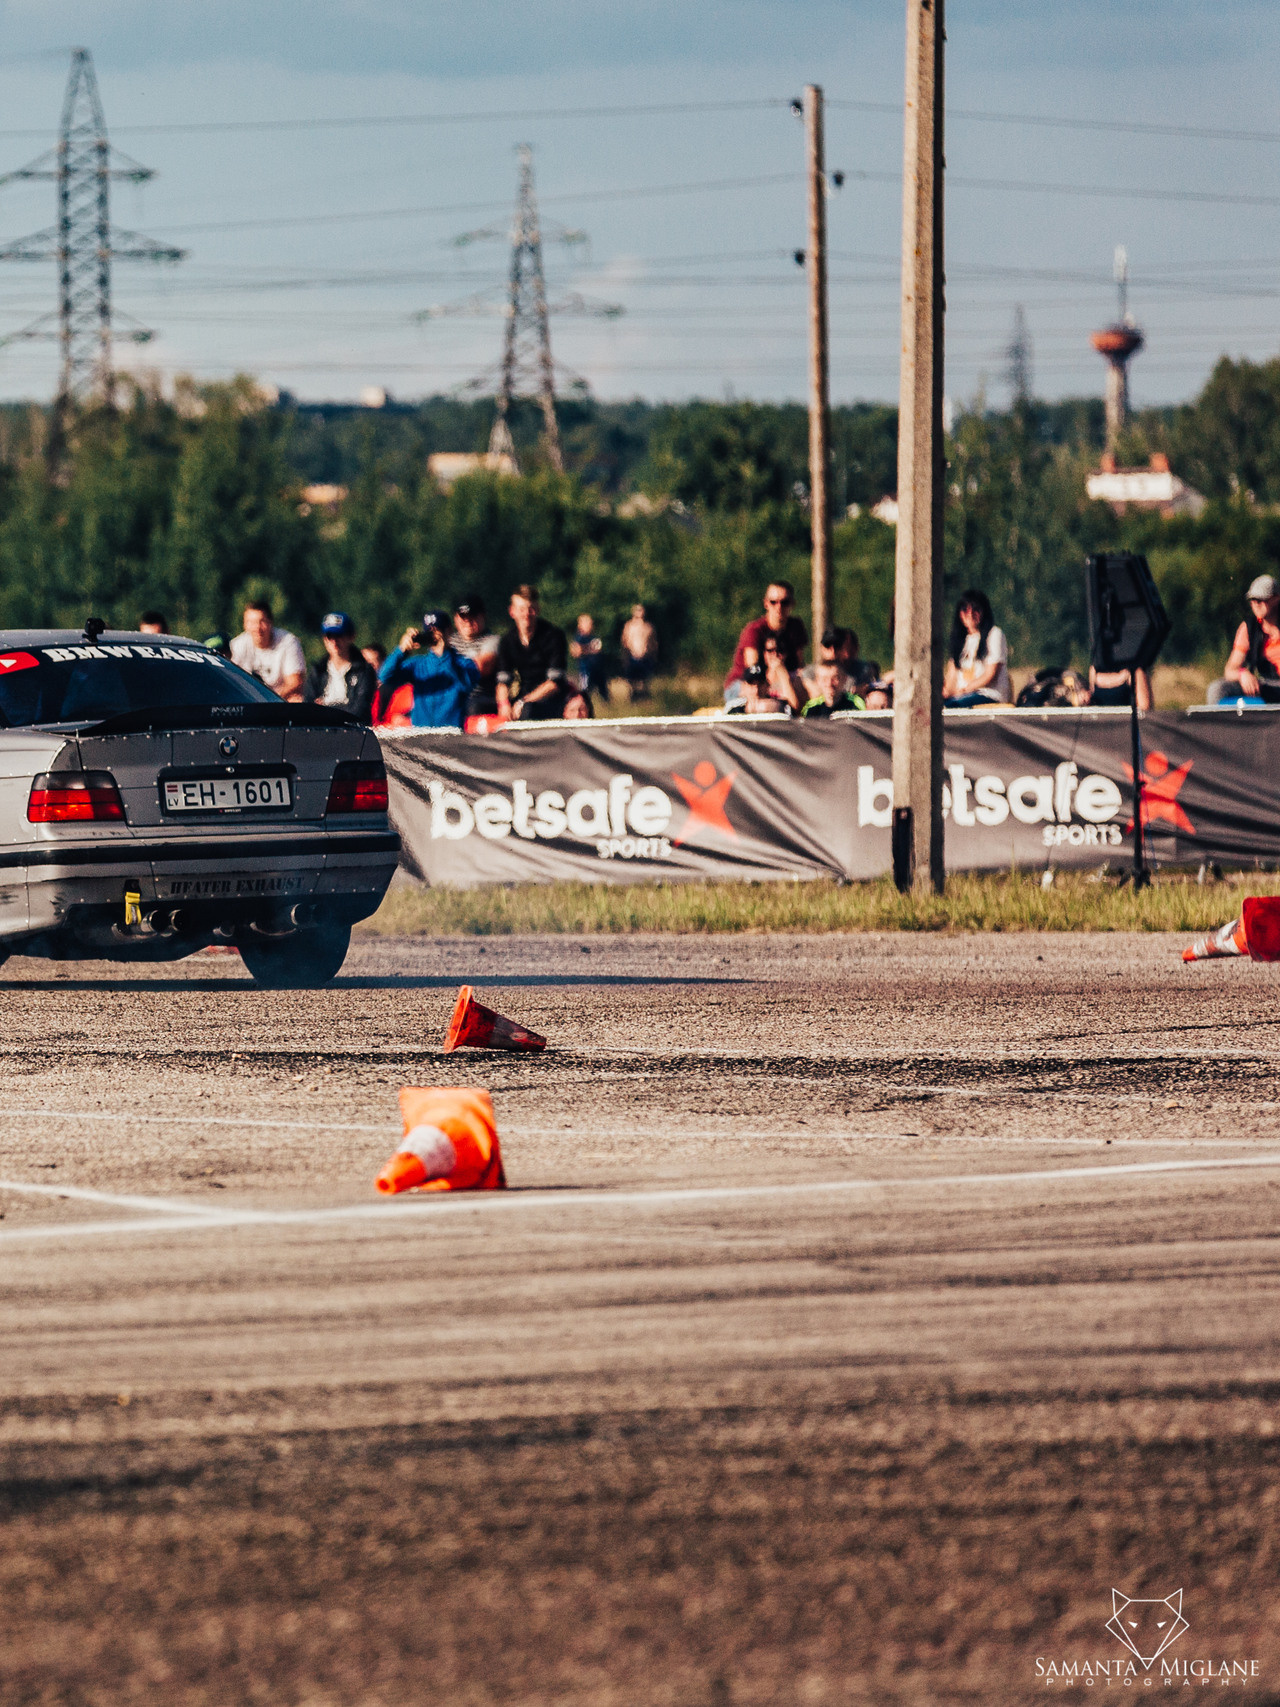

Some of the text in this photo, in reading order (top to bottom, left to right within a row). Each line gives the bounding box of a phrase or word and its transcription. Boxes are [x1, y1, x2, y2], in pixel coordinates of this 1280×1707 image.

[42, 645, 225, 668] BMWEAST
[167, 798, 179, 807] LV
[182, 780, 285, 807] EH-1601
[857, 761, 1122, 827] btsafe
[429, 773, 672, 839] betsafe
[1042, 824, 1122, 846] SPORTS
[596, 838, 672, 859] SPORTS
[171, 877, 305, 894] HEATER EXHAUST
